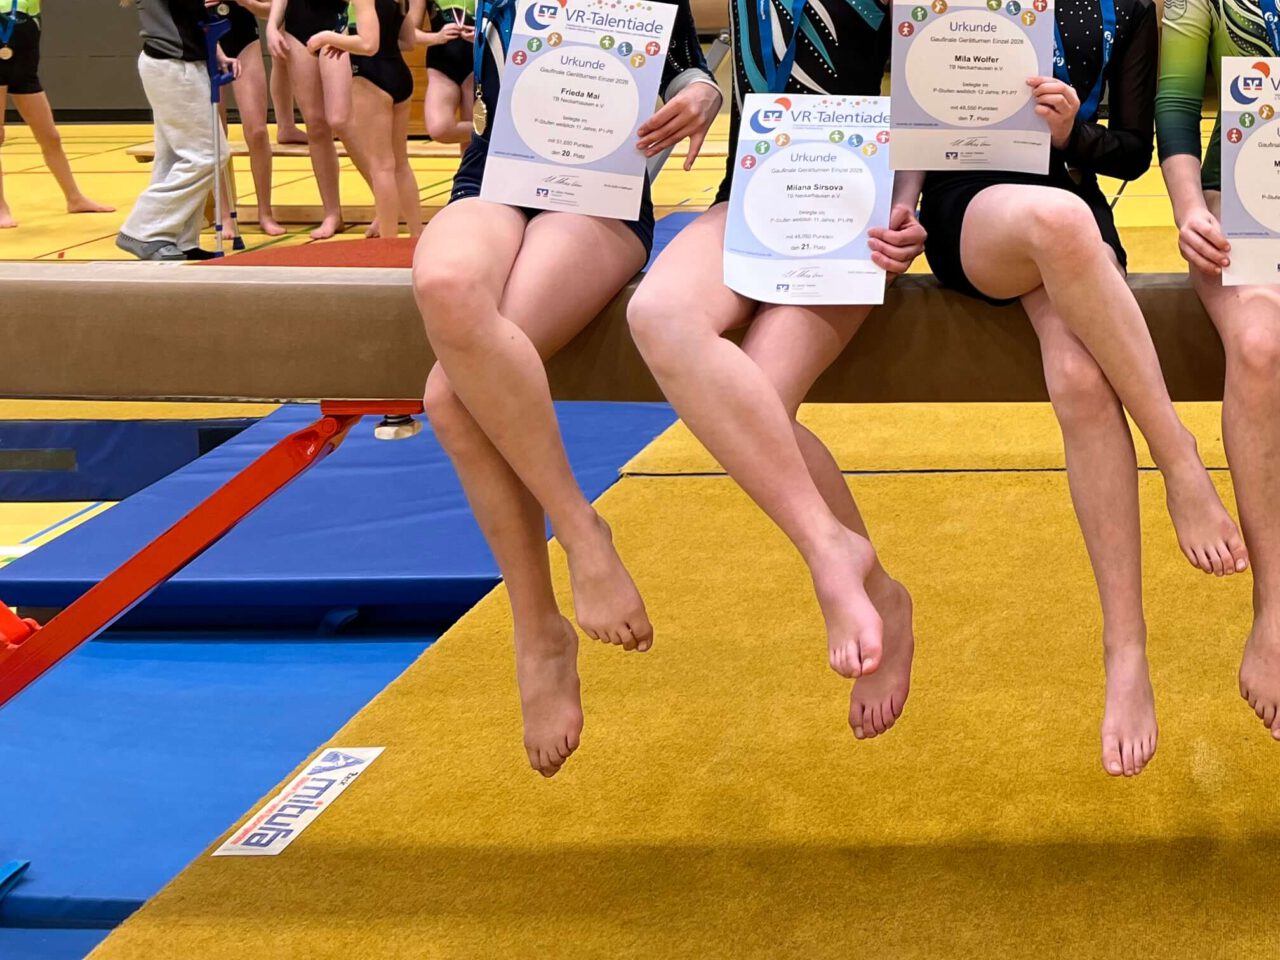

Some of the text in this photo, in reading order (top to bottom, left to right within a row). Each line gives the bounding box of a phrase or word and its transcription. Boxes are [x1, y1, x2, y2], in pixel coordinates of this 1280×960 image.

[565, 8, 663, 35] VR-Talentiade
[949, 21, 997, 32] Urkunde
[559, 55, 605, 70] Urkunde
[560, 87, 600, 99] Frieda Mai
[791, 111, 890, 123] VR-Talentiade
[790, 153, 837, 162] Urkunde
[241, 778, 336, 848] mitufa
